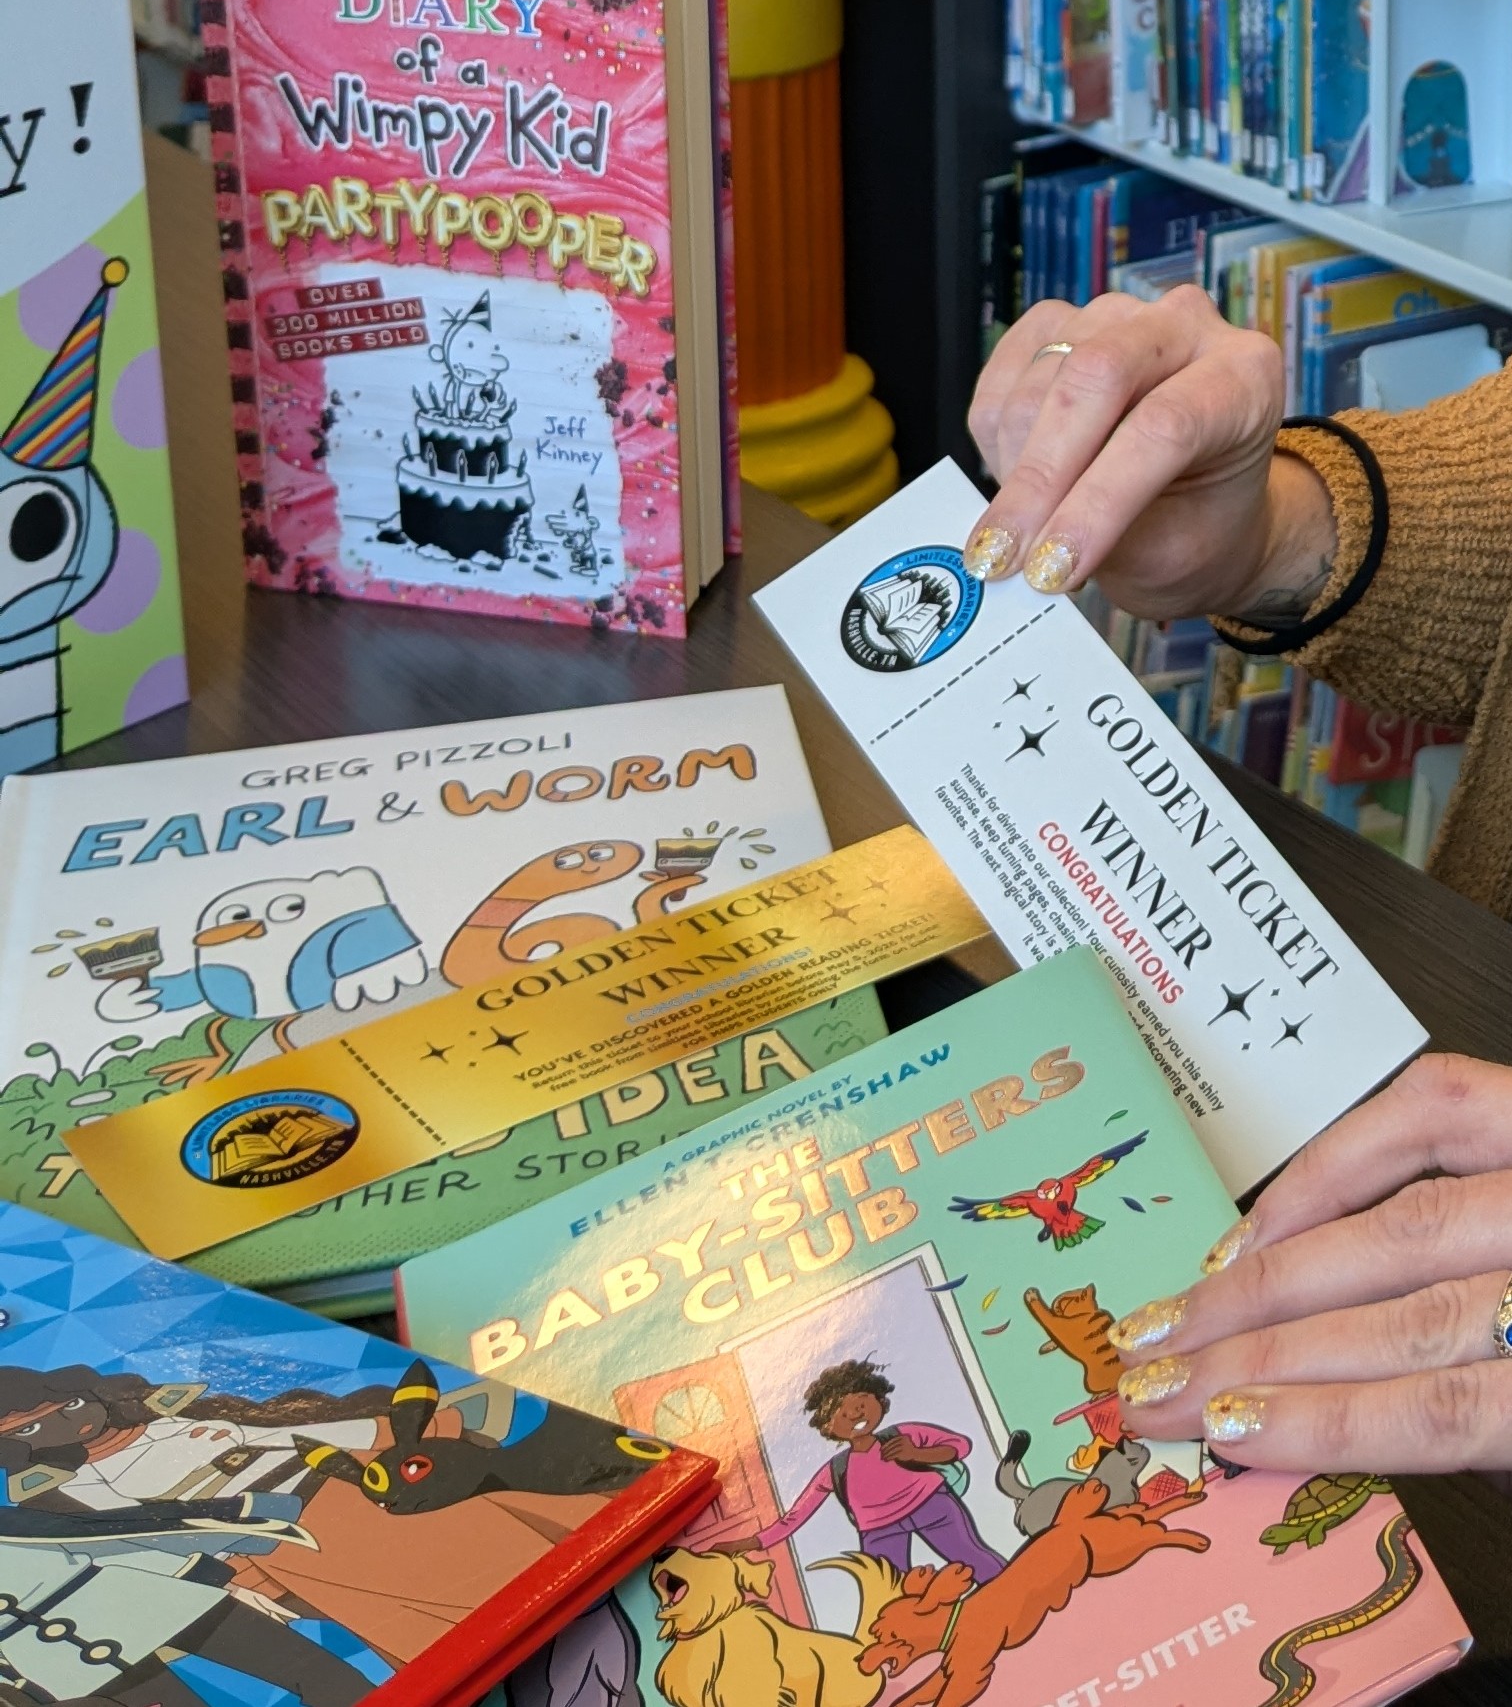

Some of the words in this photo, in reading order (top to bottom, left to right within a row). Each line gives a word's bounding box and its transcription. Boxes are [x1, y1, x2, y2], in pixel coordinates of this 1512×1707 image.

[396, 36, 444, 84] of
[459, 59, 486, 88] a
[276, 73, 491, 178] Wimpy
[504, 82, 610, 175] Kid
[263, 178, 658, 294] PARTYPOOPER
[273, 313, 318, 335] 300
[328, 301, 421, 326] MILLION
[278, 335, 353, 360] BOOKS
[364, 326, 424, 347] SOLD
[308, 282, 371, 306] OVER
[536, 442, 603, 478] Kinney
[541, 414, 587, 440] Jeff
[880, 654, 898, 666] TN
[61, 796, 354, 874] EARL
[376, 791, 423, 825] &
[439, 743, 758, 818] WORM
[241, 758, 373, 790] GREG
[396, 731, 572, 772] PIZZOLI
[934, 785, 968, 831] favorites.
[966, 828, 983, 850] The
[980, 846, 1000, 873] next
[997, 870, 1028, 911] magical
[1026, 906, 1048, 937] story
[1045, 930, 1056, 948] is
[1080, 798, 1213, 971] WINNER
[1086, 692, 1230, 849] GOLDEN
[1208, 836, 1340, 991] TICKET
[476, 928, 676, 1012] GOLDEN
[676, 864, 840, 936] TICKET
[598, 926, 800, 1007] WINNER
[950, 777, 981, 819] surprise.
[979, 815, 1001, 843] Keep
[998, 841, 1024, 881] turning
[1021, 875, 1048, 913] pages,
[1184, 1092, 1207, 1117] new
[960, 763, 989, 799] Thanks
[989, 796, 1001, 813] for
[997, 812, 1022, 845] diving
[1018, 838, 1037, 863] into
[1033, 860, 1051, 880] our
[1047, 877, 1088, 931] collection!
[1086, 929, 1107, 956] Your
[1103, 955, 1140, 999] curiosity
[1137, 999, 1171, 1037] earned
[1163, 1035, 1184, 1059] you
[1181, 1057, 1201, 1081] this
[1199, 1080, 1224, 1112] shiny
[1022, 932, 1032, 946] it
[1038, 821, 1184, 1005] CONGRATULATIONS
[513, 1049, 587, 1082] YOU'VE
[590, 1003, 703, 1053] DISCOVERED
[709, 997, 724, 1007] A
[726, 969, 795, 999] GOLDEN
[798, 938, 872, 971] READING
[874, 914, 934, 940] TICKET!
[532, 1068, 576, 1089] Return
[578, 1056, 604, 1070] this
[605, 1040, 644, 1060] ticket
[646, 1033, 661, 1042] to
[663, 1022, 692, 1038] your
[694, 1005, 734, 1025] school
[734, 985, 785, 1014] librarian
[787, 970, 824, 989] before
[826, 957, 851, 973] May
[549, 1078, 577, 1092] free
[579, 1064, 614, 1079] book
[614, 1051, 645, 1066] from
[647, 1028, 701, 1052] Limitless
[703, 1004, 757, 1031] Libraries
[758, 997, 772, 1010] by
[774, 974, 842, 1007] completing
[841, 963, 862, 976] the
[863, 952, 890, 968] form
[682, 1033, 708, 1049] FOR
[746, 995, 806, 1024] STUDENTS
[808, 982, 839, 999] ONLY
[553, 1028, 816, 1140] IDEA
[568, 1165, 693, 1239] ELLEN
[744, 1043, 952, 1162] CRENSHAW
[662, 1158, 676, 1174] A
[679, 1126, 747, 1166] GRAPHIC
[748, 1091, 828, 1137] NOVEL
[829, 1075, 855, 1097] BY
[468, 1045, 1087, 1375] BABY-SITTERS
[719, 1136, 824, 1200] THE
[682, 1186, 919, 1325] CLUB
